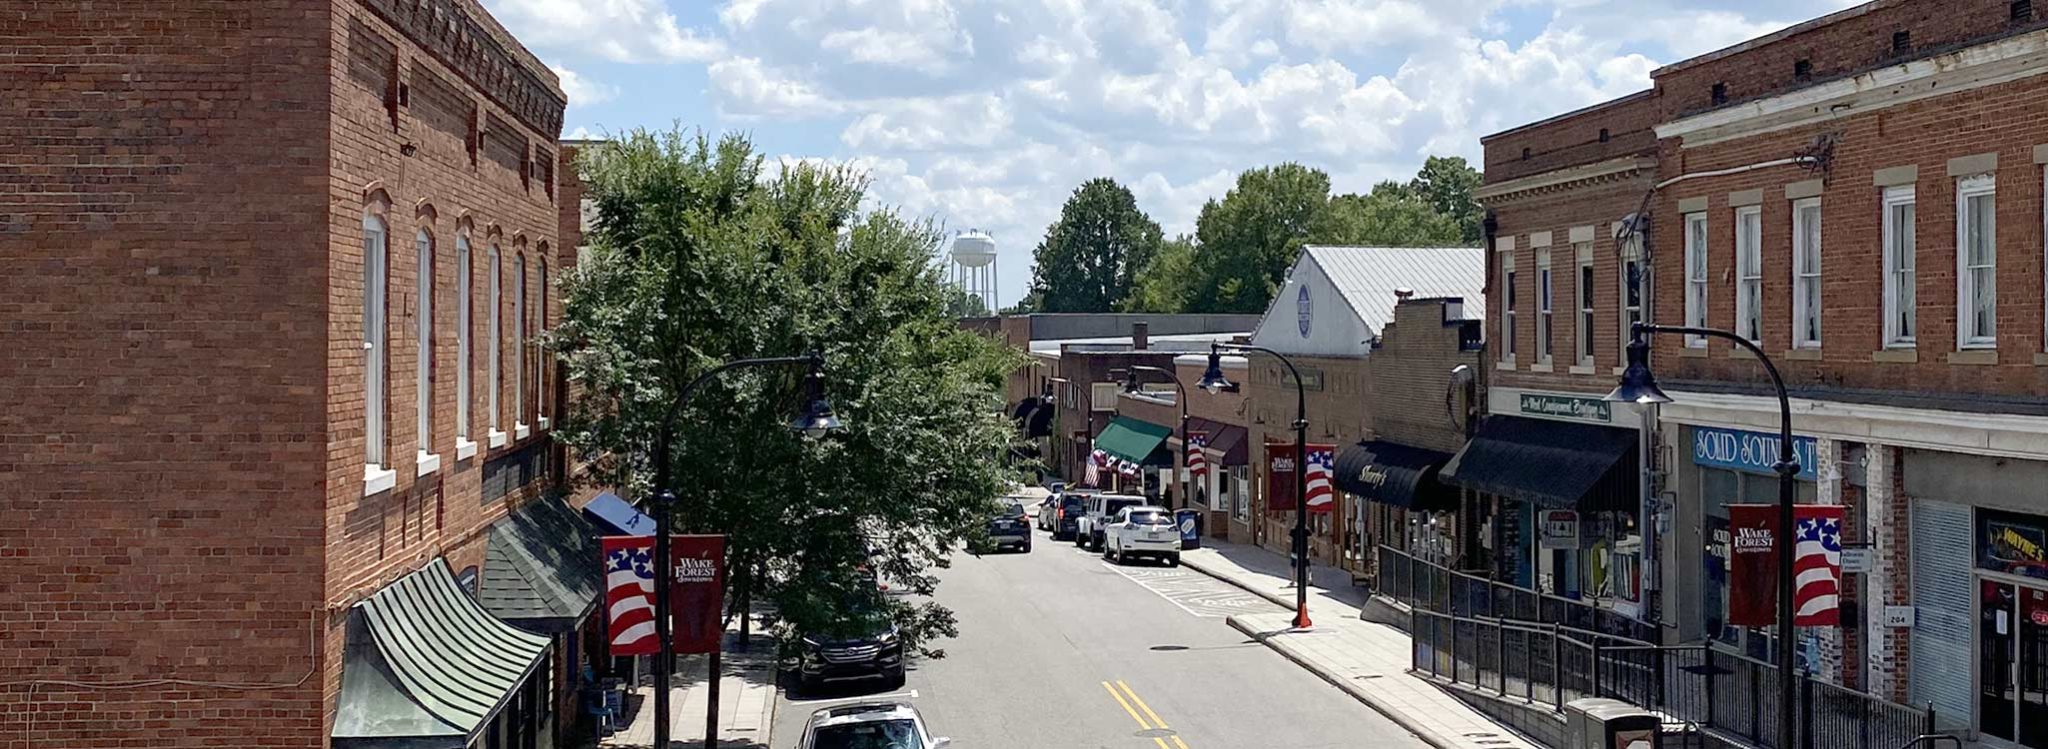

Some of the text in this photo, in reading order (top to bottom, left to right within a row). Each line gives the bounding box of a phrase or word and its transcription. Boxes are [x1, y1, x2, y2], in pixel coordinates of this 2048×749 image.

[1696, 430, 1737, 462] SOLID
[1741, 434, 1801, 467] SOUNS
[1359, 464, 1388, 490] Shorty's
[1738, 527, 1771, 539] WAKE
[1734, 535, 1774, 548] FOREST
[2004, 527, 2045, 562] WAYNE'S
[680, 557, 715, 569] WAKE
[674, 565, 717, 577] FOREST
